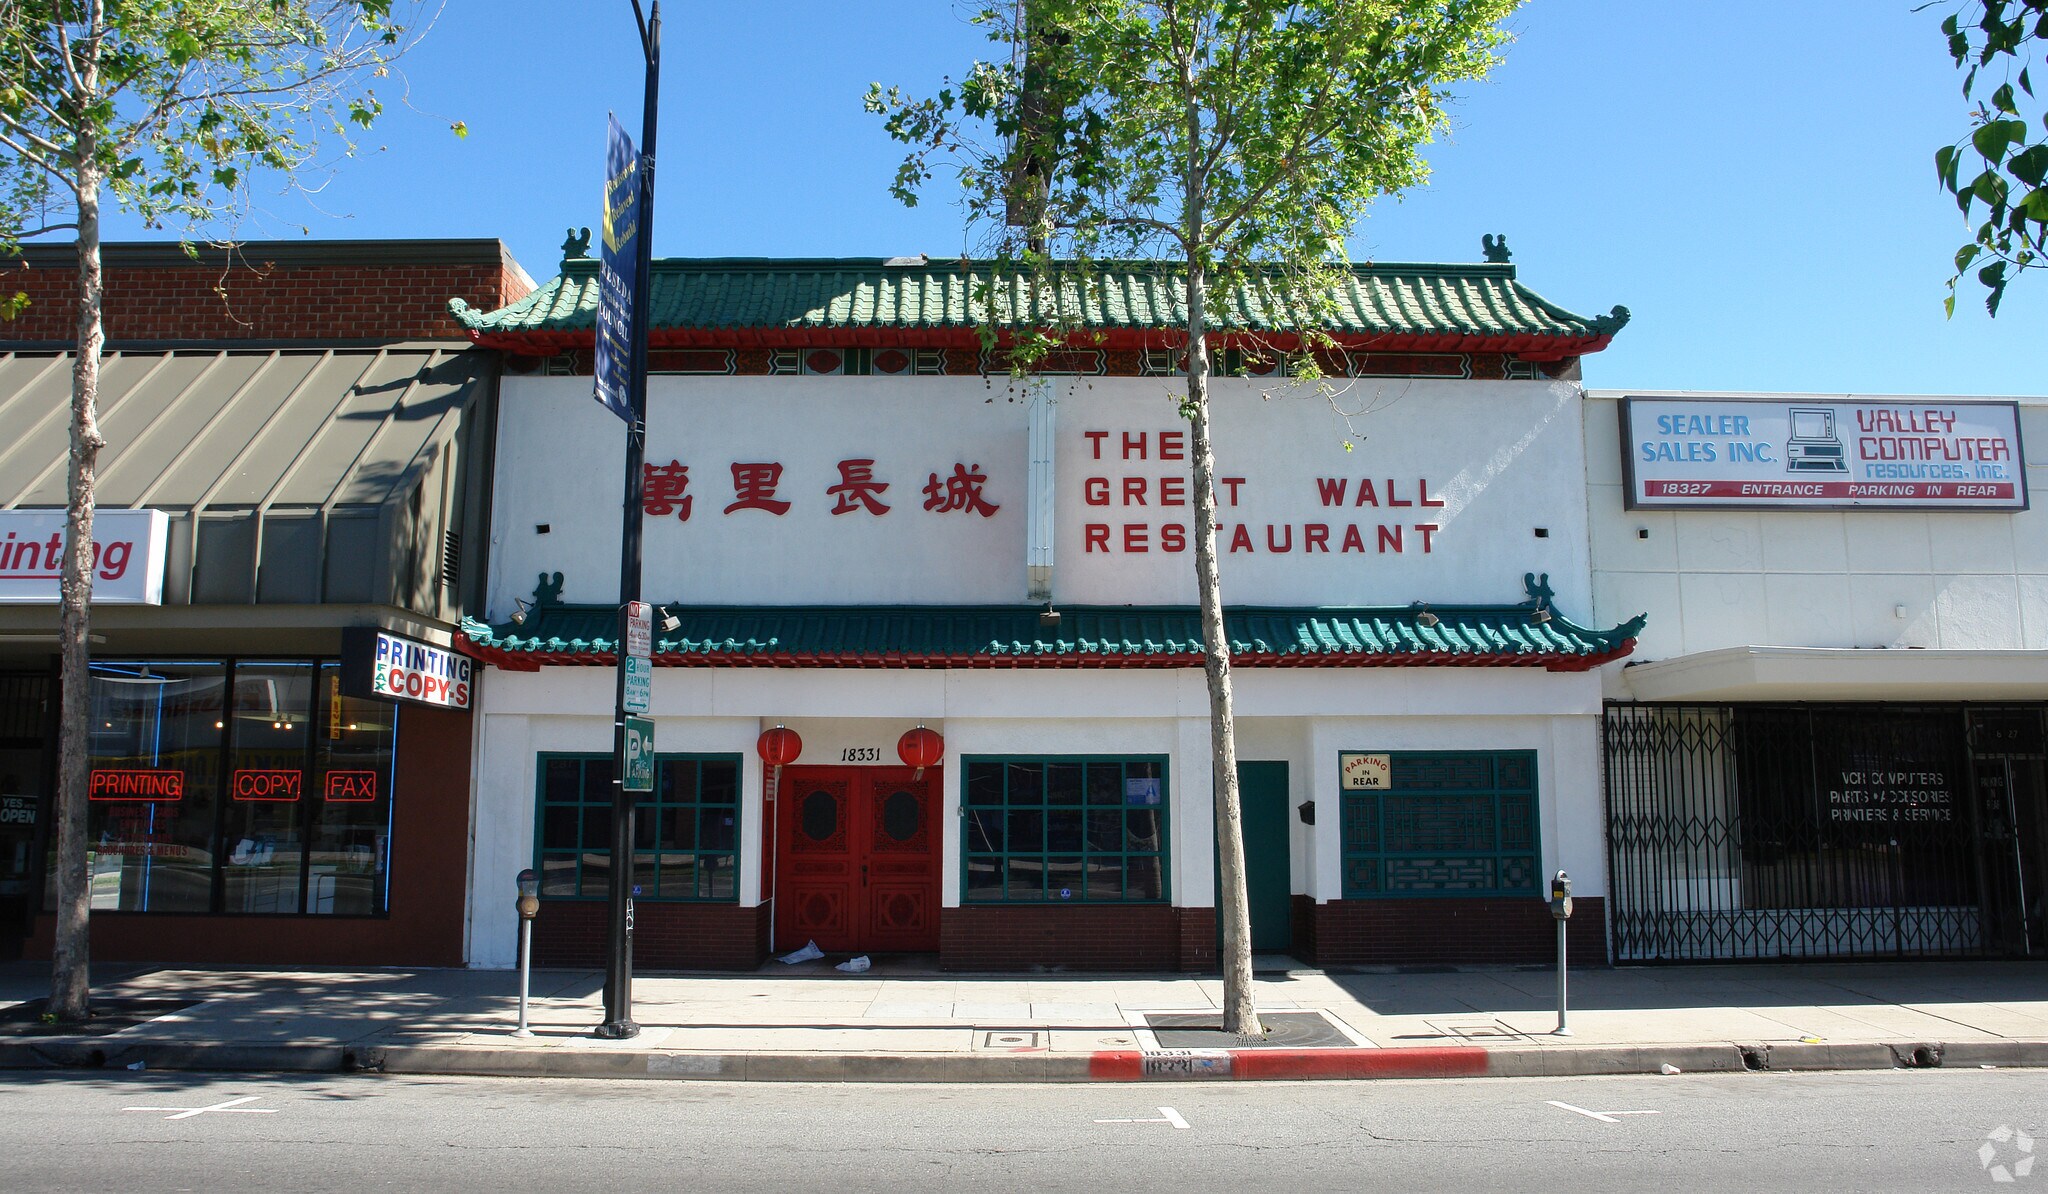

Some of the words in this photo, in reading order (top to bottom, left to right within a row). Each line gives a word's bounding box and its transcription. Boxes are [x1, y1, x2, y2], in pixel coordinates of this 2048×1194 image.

[601, 258, 632, 306] RESEDA
[599, 300, 630, 342] COUNCIL
[1657, 414, 1751, 436] SEALER
[1857, 409, 1956, 433] VALLEY
[1085, 431, 1184, 460] THE
[1642, 441, 1719, 463] SALES
[1729, 441, 1779, 463] INC.
[1859, 437, 2011, 461] COMPUTER
[1975, 460, 2011, 479] inc.
[643, 459, 1000, 521] 萬里長城
[1085, 477, 1246, 506] GRET
[1317, 478, 1445, 507] WALL
[1662, 483, 1712, 495] 18327
[1741, 484, 1824, 496] ENTRANCE
[1849, 484, 1915, 496] PARKING
[1926, 485, 1942, 496] IN
[1957, 485, 1997, 496] REAR
[1085, 524, 1439, 554] RESAURANT
[630, 603, 639, 617] NO
[630, 618, 650, 630] PARKING
[377, 637, 469, 682] PRINTING
[627, 659, 635, 671] 2
[637, 662, 649, 673] HOUR
[375, 663, 387, 691] FAX
[389, 669, 468, 706] COPY-S
[627, 675, 650, 687] PARKING
[626, 729, 642, 778] P
[841, 748, 881, 762] 18331
[1345, 757, 1388, 774] PARKING
[93, 775, 180, 796] PRINTING
[238, 775, 298, 796] COPY
[331, 776, 373, 797] FAX
[1353, 777, 1379, 786] REAR
[3, 798, 24, 808] YES
[1, 808, 36, 824] OPEN
[1892, 809, 1900, 821] &
[157, 846, 189, 856] MENUS
